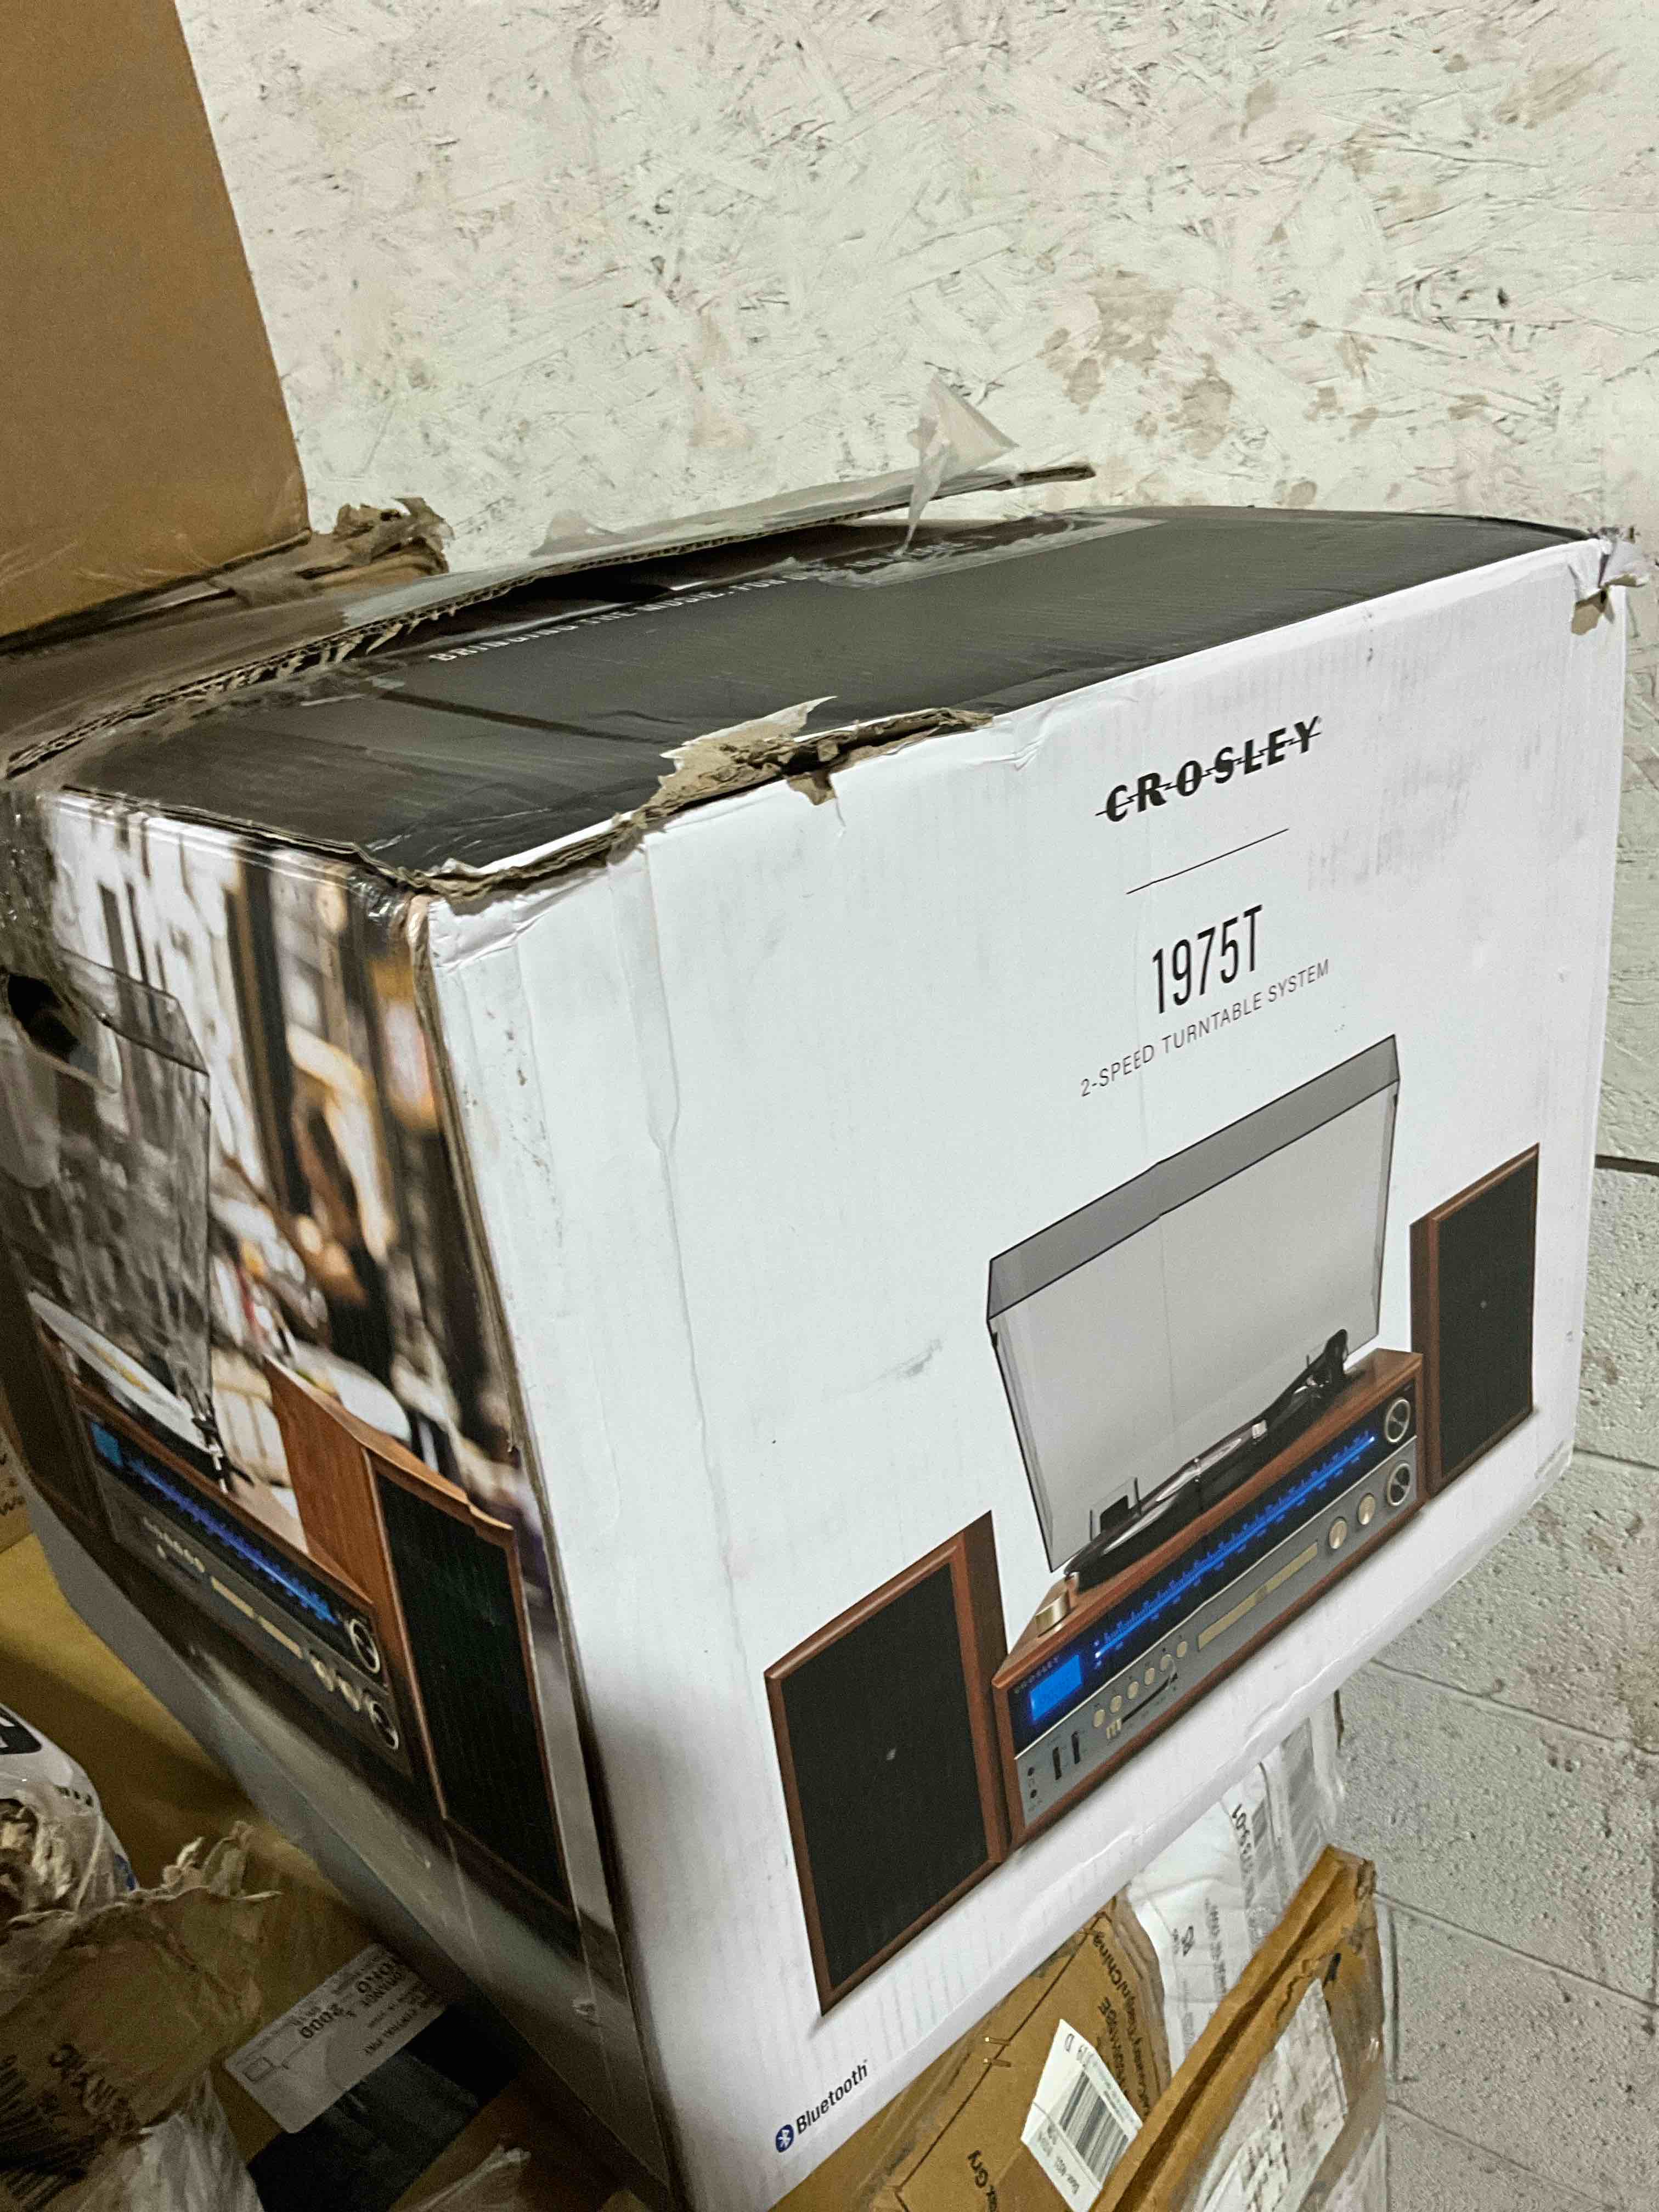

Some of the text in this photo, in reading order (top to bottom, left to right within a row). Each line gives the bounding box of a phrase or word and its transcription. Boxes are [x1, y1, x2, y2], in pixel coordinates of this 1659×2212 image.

[1096, 715, 1321, 822] CROSLEY
[1152, 904, 1262, 1014] 1975T
[1080, 958, 1329, 1097] 2-SPEED TURNTABLE SYSTEM
[795, 2062, 868, 2135] Bluetooth
